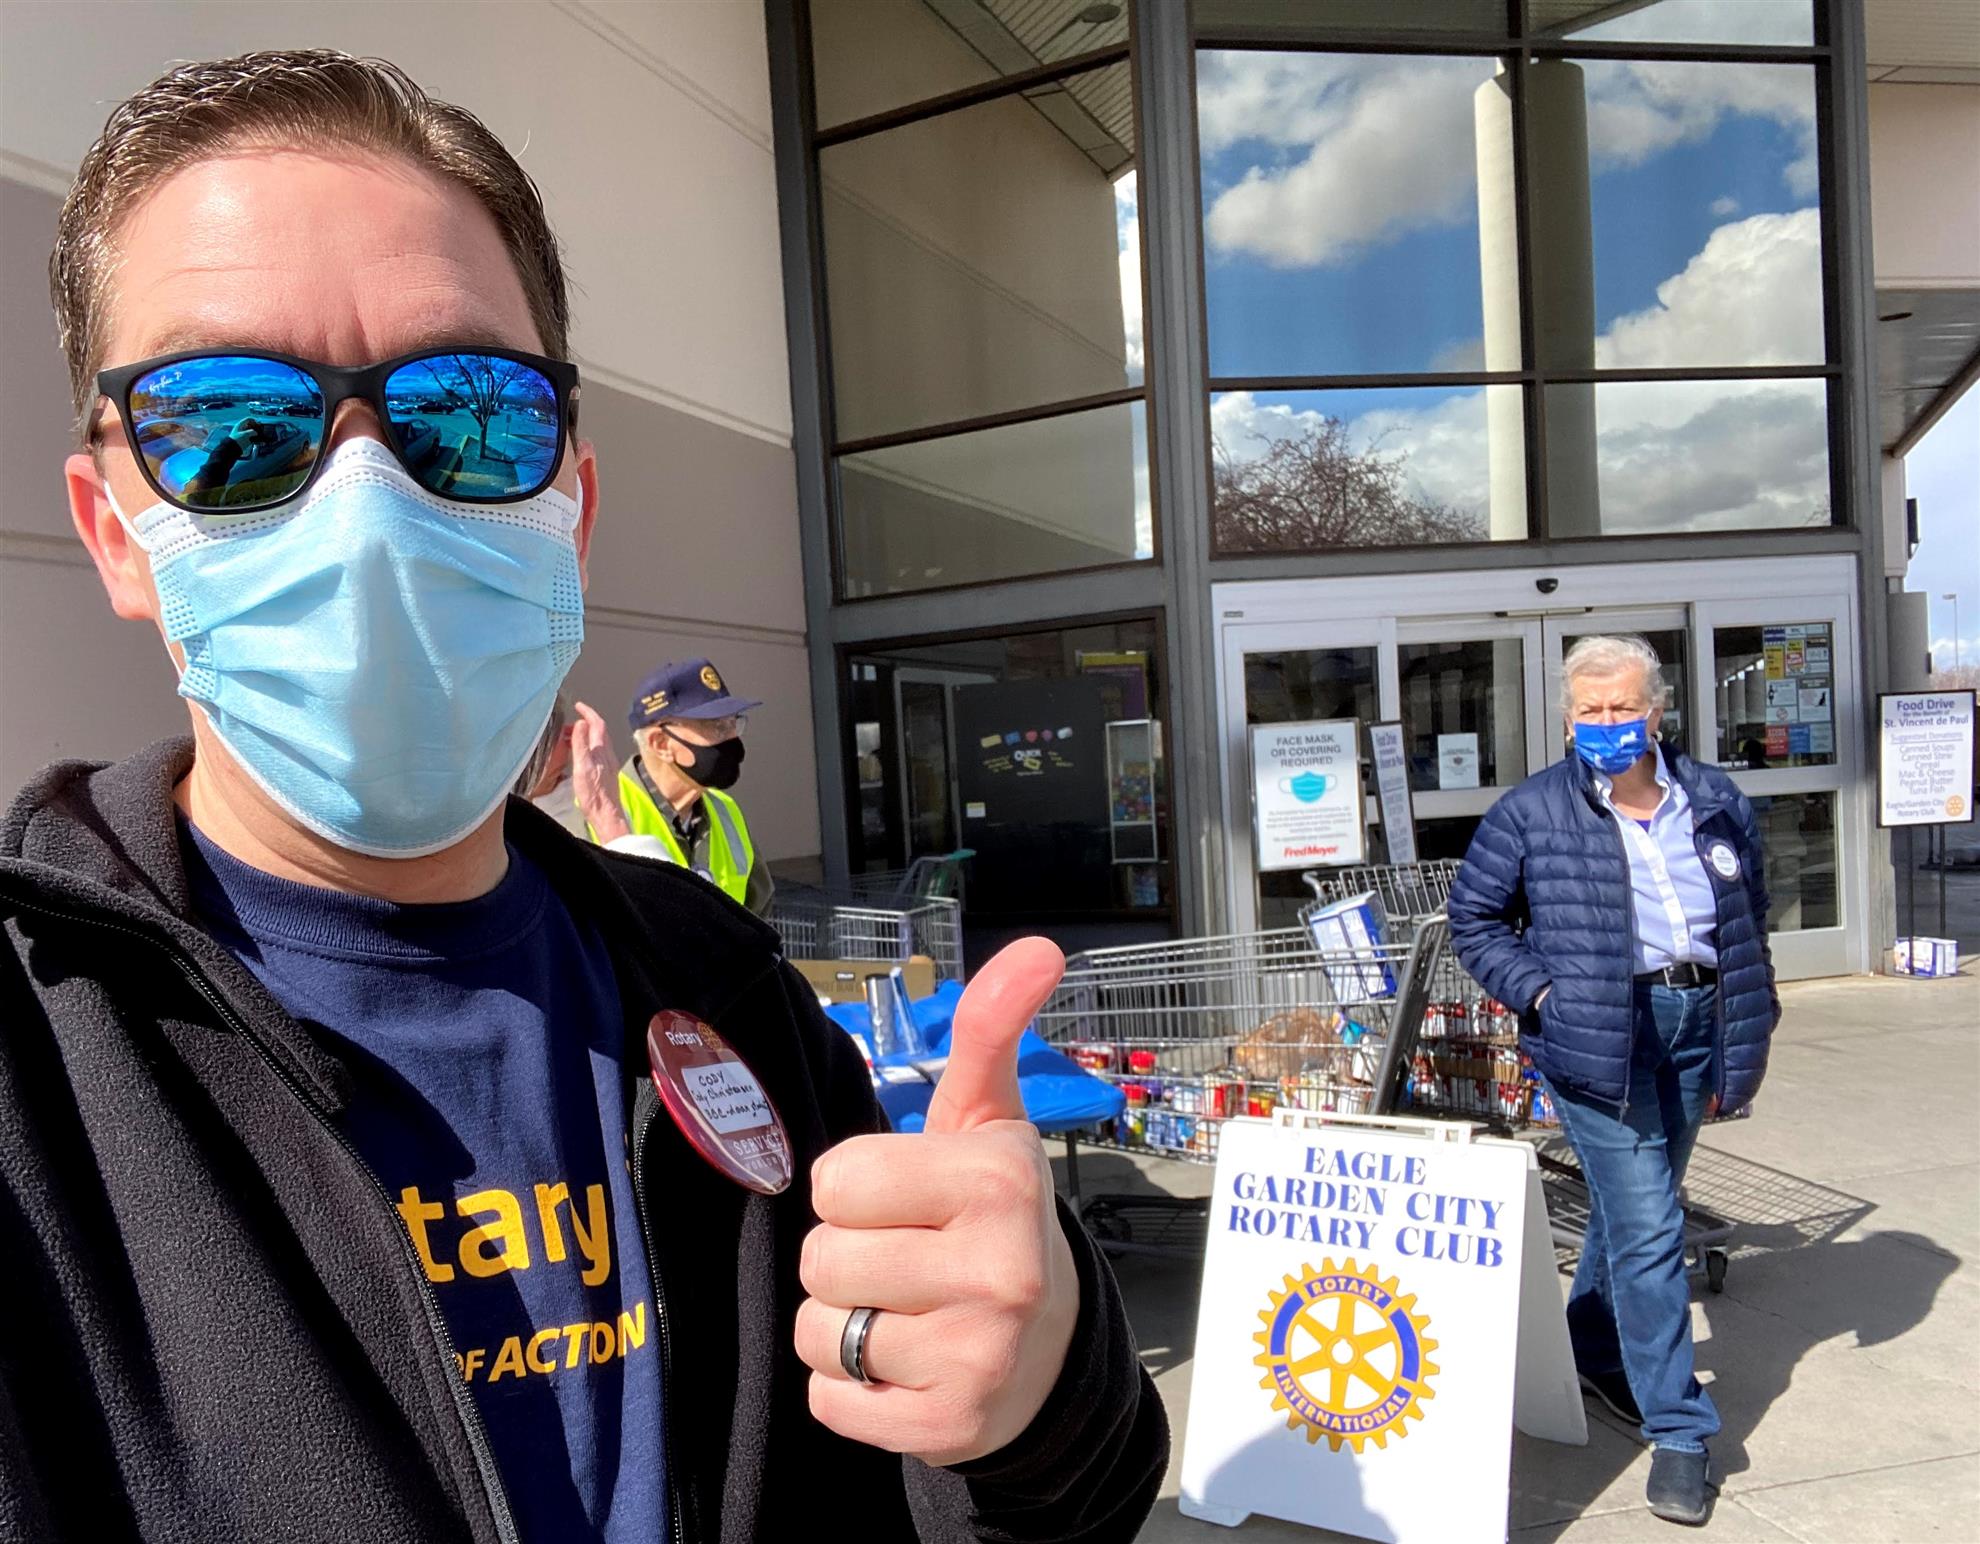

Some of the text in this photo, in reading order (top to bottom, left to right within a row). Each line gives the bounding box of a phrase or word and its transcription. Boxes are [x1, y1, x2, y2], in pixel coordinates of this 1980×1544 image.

[1897, 699, 1955, 711] Food Drive
[1884, 715, 1969, 728] St. Vincent de Paul
[1276, 734, 1335, 746] FACE MASK
[1270, 745, 1342, 757] OR COVERING
[1280, 756, 1334, 768] REQUIRED
[665, 1031, 703, 1047] Rotary
[698, 1070, 725, 1087] CODY
[1304, 1146, 1427, 1186] EAGLE
[1233, 1171, 1505, 1231] GARDEN CITY
[1227, 1205, 1503, 1268] ROTARY CLUB
[1311, 1277, 1386, 1304] ROTARY
[1276, 1370, 1407, 1431] INTERNATIONAL
